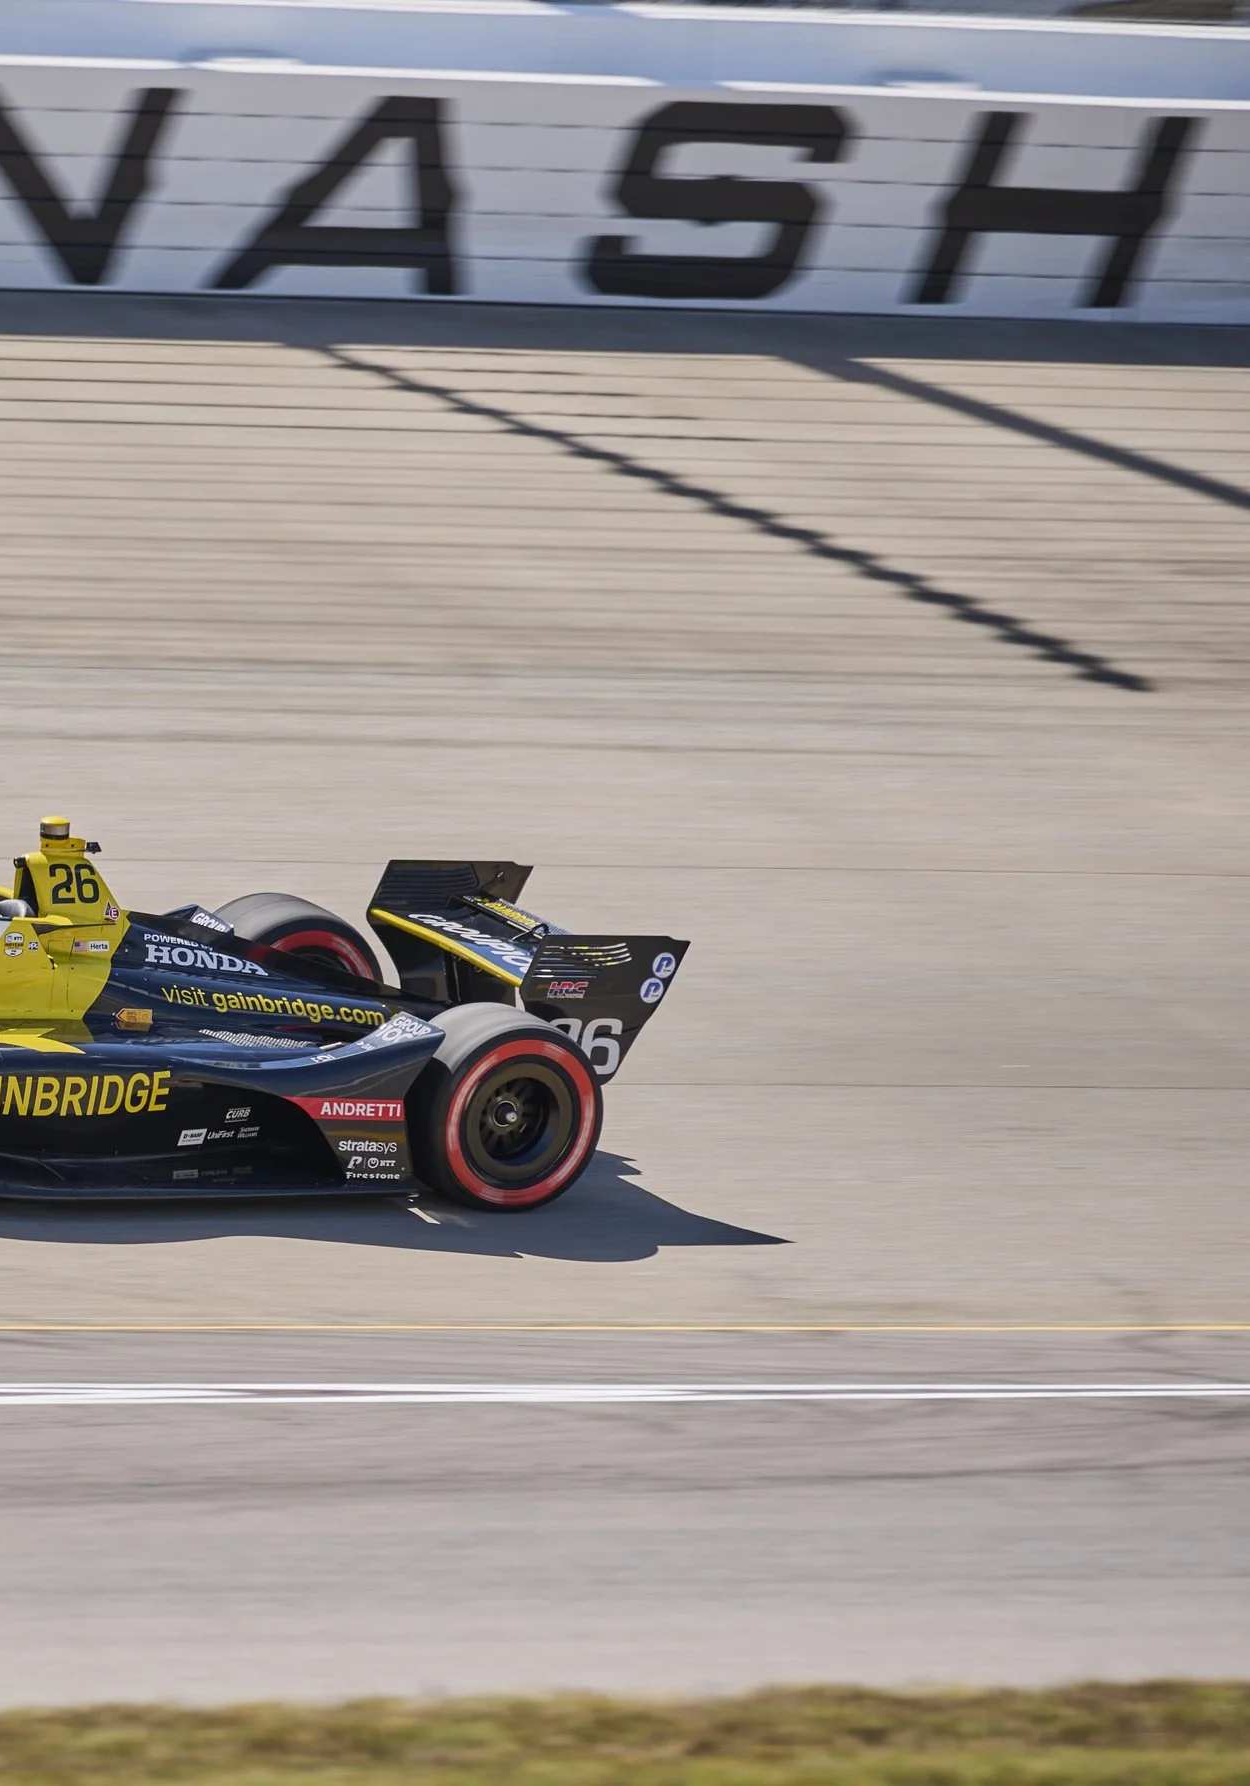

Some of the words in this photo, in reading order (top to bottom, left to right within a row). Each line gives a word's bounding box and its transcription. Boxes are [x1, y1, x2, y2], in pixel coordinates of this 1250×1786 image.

[49, 863, 100, 904] 26
[144, 933, 199, 947] POWERED
[144, 944, 269, 977] HONDA
[162, 984, 209, 1007] visit
[212, 991, 386, 1026] gainbridge.com
[393, 1016, 432, 1036] GROUP
[225, 1109, 251, 1119] CURB
[320, 1102, 401, 1117] ANDRETTI
[207, 1130, 235, 1140] UniFirst
[338, 1140, 398, 1154] stratasys
[345, 1171, 400, 1179] Firestone
